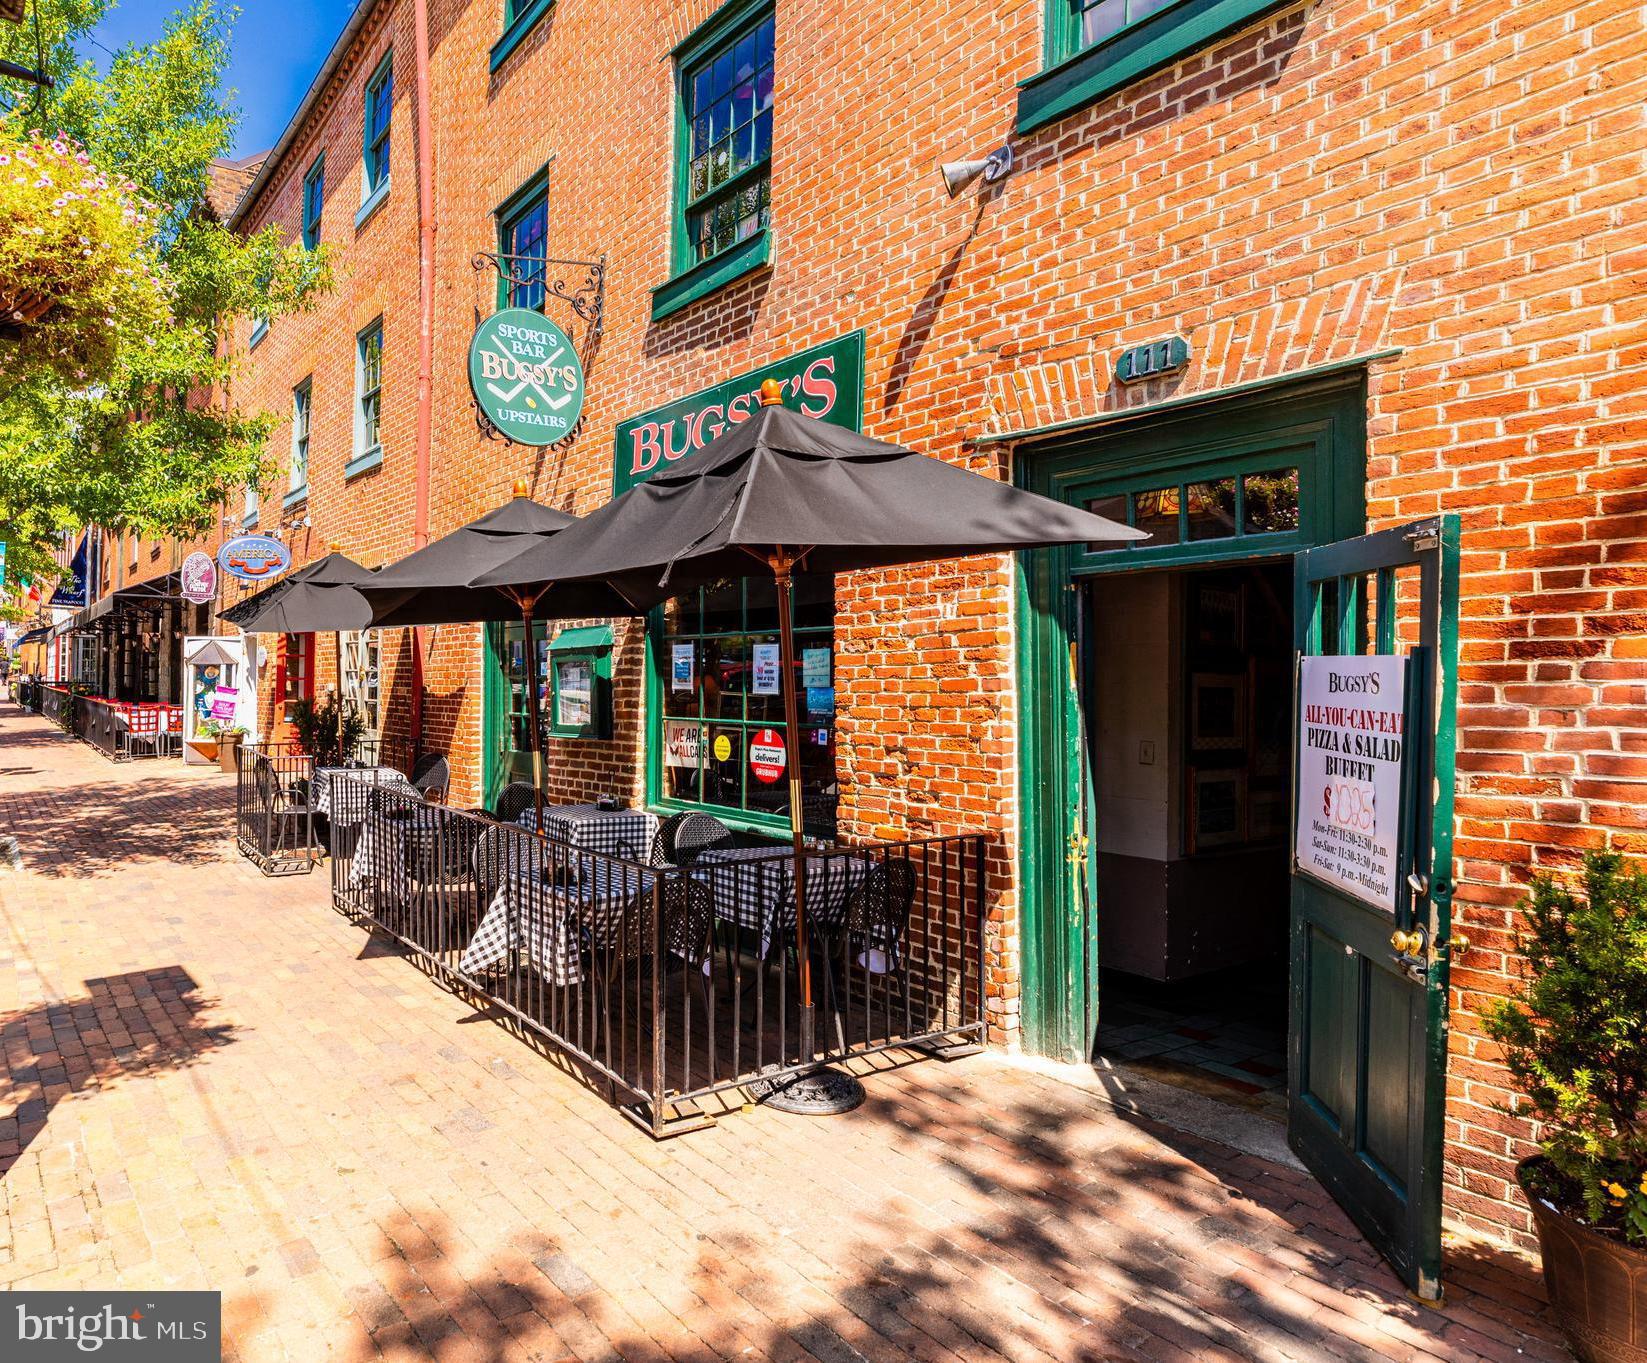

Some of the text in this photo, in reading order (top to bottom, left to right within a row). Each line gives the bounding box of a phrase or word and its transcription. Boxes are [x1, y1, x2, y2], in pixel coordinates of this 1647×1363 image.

[498, 323, 558, 347] SPORTS
[511, 340, 547, 359] BAR
[1126, 338, 1177, 378] 111
[479, 350, 579, 393] BUGSY'S
[497, 407, 567, 429] UPSTAIRS
[226, 548, 282, 560] AMERICA
[673, 728, 701, 744] WE ARE
[1307, 727, 1402, 763] PIZZA & SALAD
[755, 752, 780, 764] delivers!
[1325, 755, 1375, 782] BUFFET
[1312, 819, 1388, 858] Mon-Fri: 11:30-2:30 p.m.
[1312, 836, 1386, 876] Sat-Sun: 11:30-3:30 p.m.
[1313, 854, 1335, 871] Fri-Sat:
[1336, 863, 1342, 872] 9
